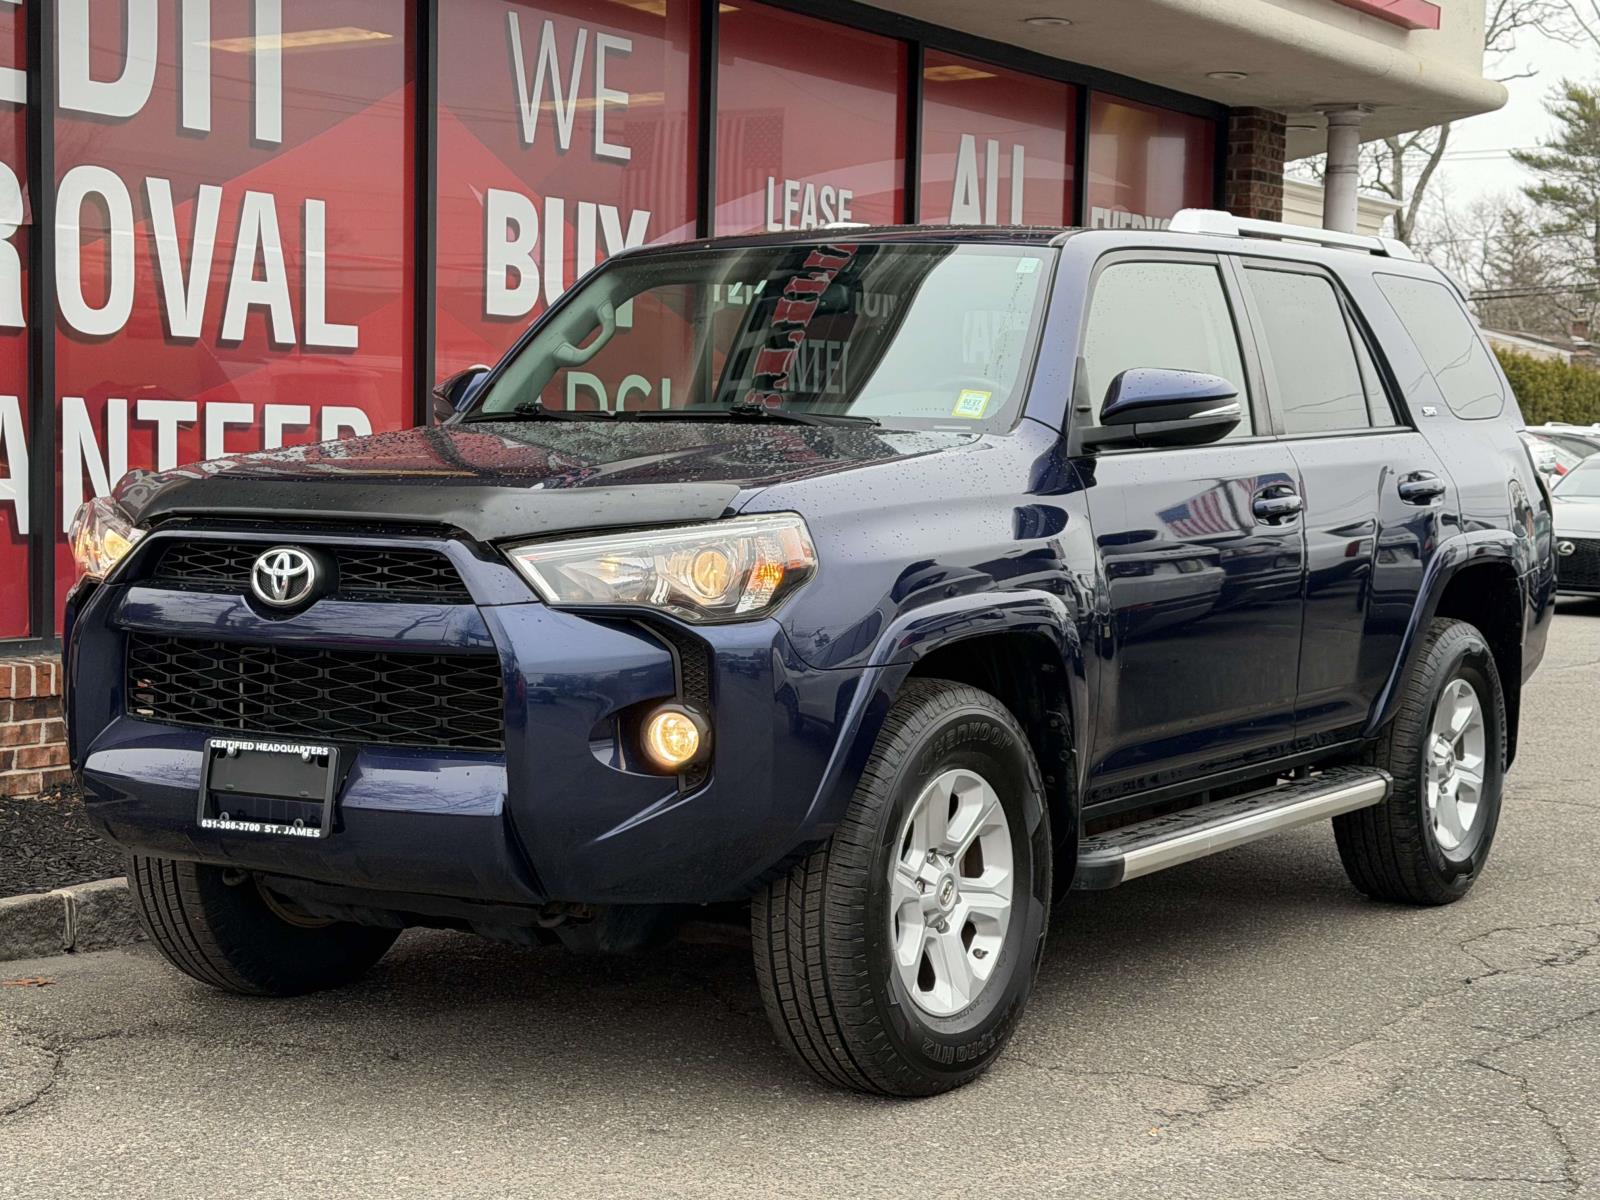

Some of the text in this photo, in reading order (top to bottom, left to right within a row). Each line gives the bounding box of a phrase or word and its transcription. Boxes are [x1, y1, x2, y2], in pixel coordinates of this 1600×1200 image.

[0, 0, 282, 143] DIT
[508, 11, 632, 160] WE
[767, 176, 853, 231] LEASE
[486, 187, 651, 327] BUY
[210, 739, 328, 756] CERTIFIED HEADQUARTERS
[264, 825, 281, 834] ST.
[284, 826, 320, 838] JAMES
